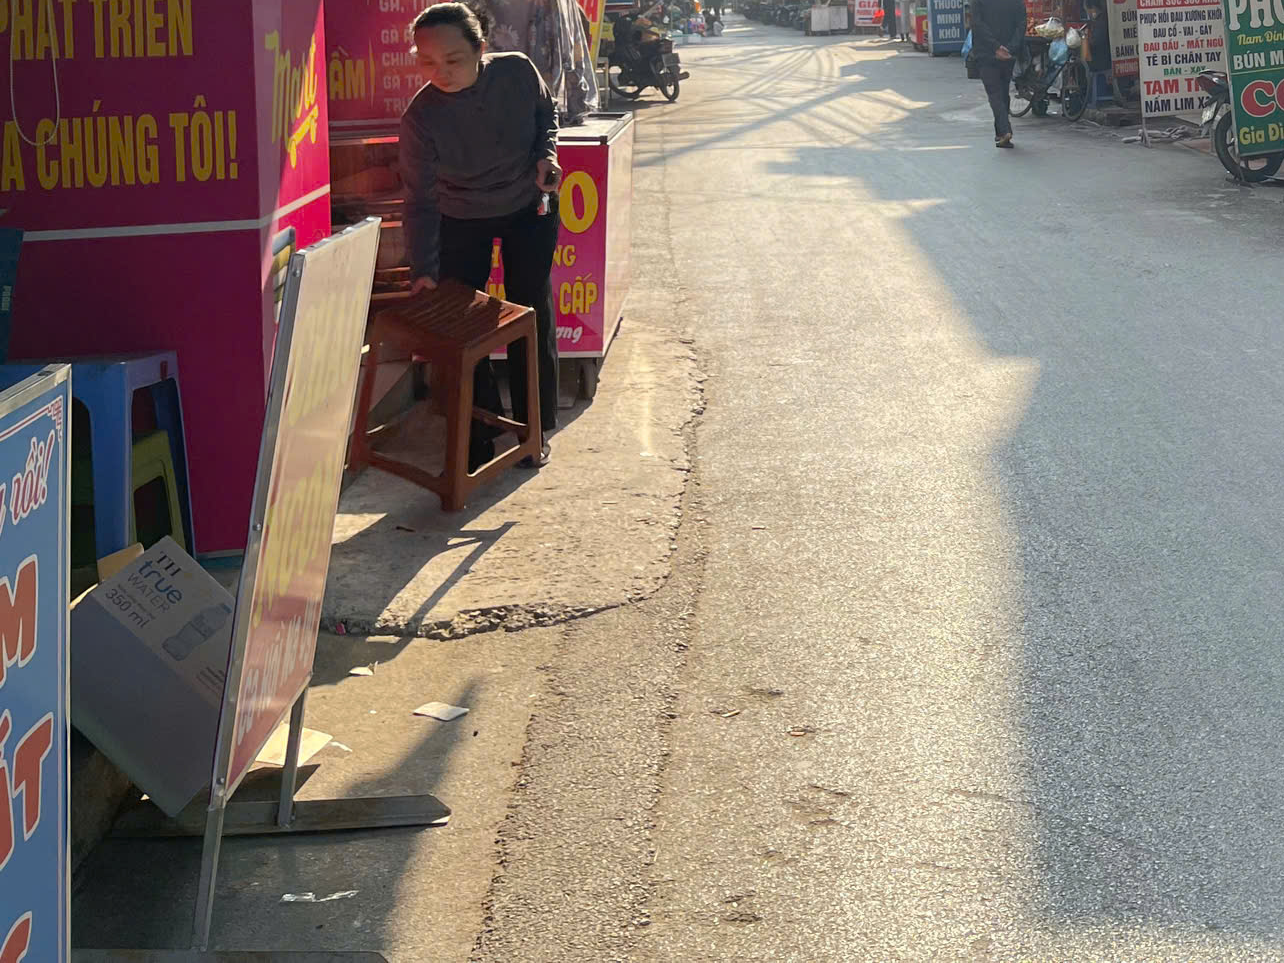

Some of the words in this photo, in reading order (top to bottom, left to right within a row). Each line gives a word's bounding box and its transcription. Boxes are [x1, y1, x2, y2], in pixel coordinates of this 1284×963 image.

[936, 12, 961, 25] MINH
[1153, 23, 1168, 38] ĐAU
[1183, 23, 1193, 36] VAI
[1143, 39, 1160, 52] ĐAU
[1206, 34, 1224, 48] NGỦ
[1175, 51, 1203, 65] CHÂN
[1205, 51, 1221, 63] TAY
[1233, 50, 1266, 71] BÚN
[1143, 79, 1180, 96] TAM
[1144, 96, 1171, 114] NẤM
[1174, 98, 1194, 111] LIM
[35, 99, 160, 190] CHÚNG
[169, 94, 239, 182] TÔI!
[1239, 125, 1265, 145] Gia
[559, 272, 599, 315] CẤP
[138, 560, 183, 605] true
[105, 588, 132, 612] 350
[127, 572, 171, 614] WATER
